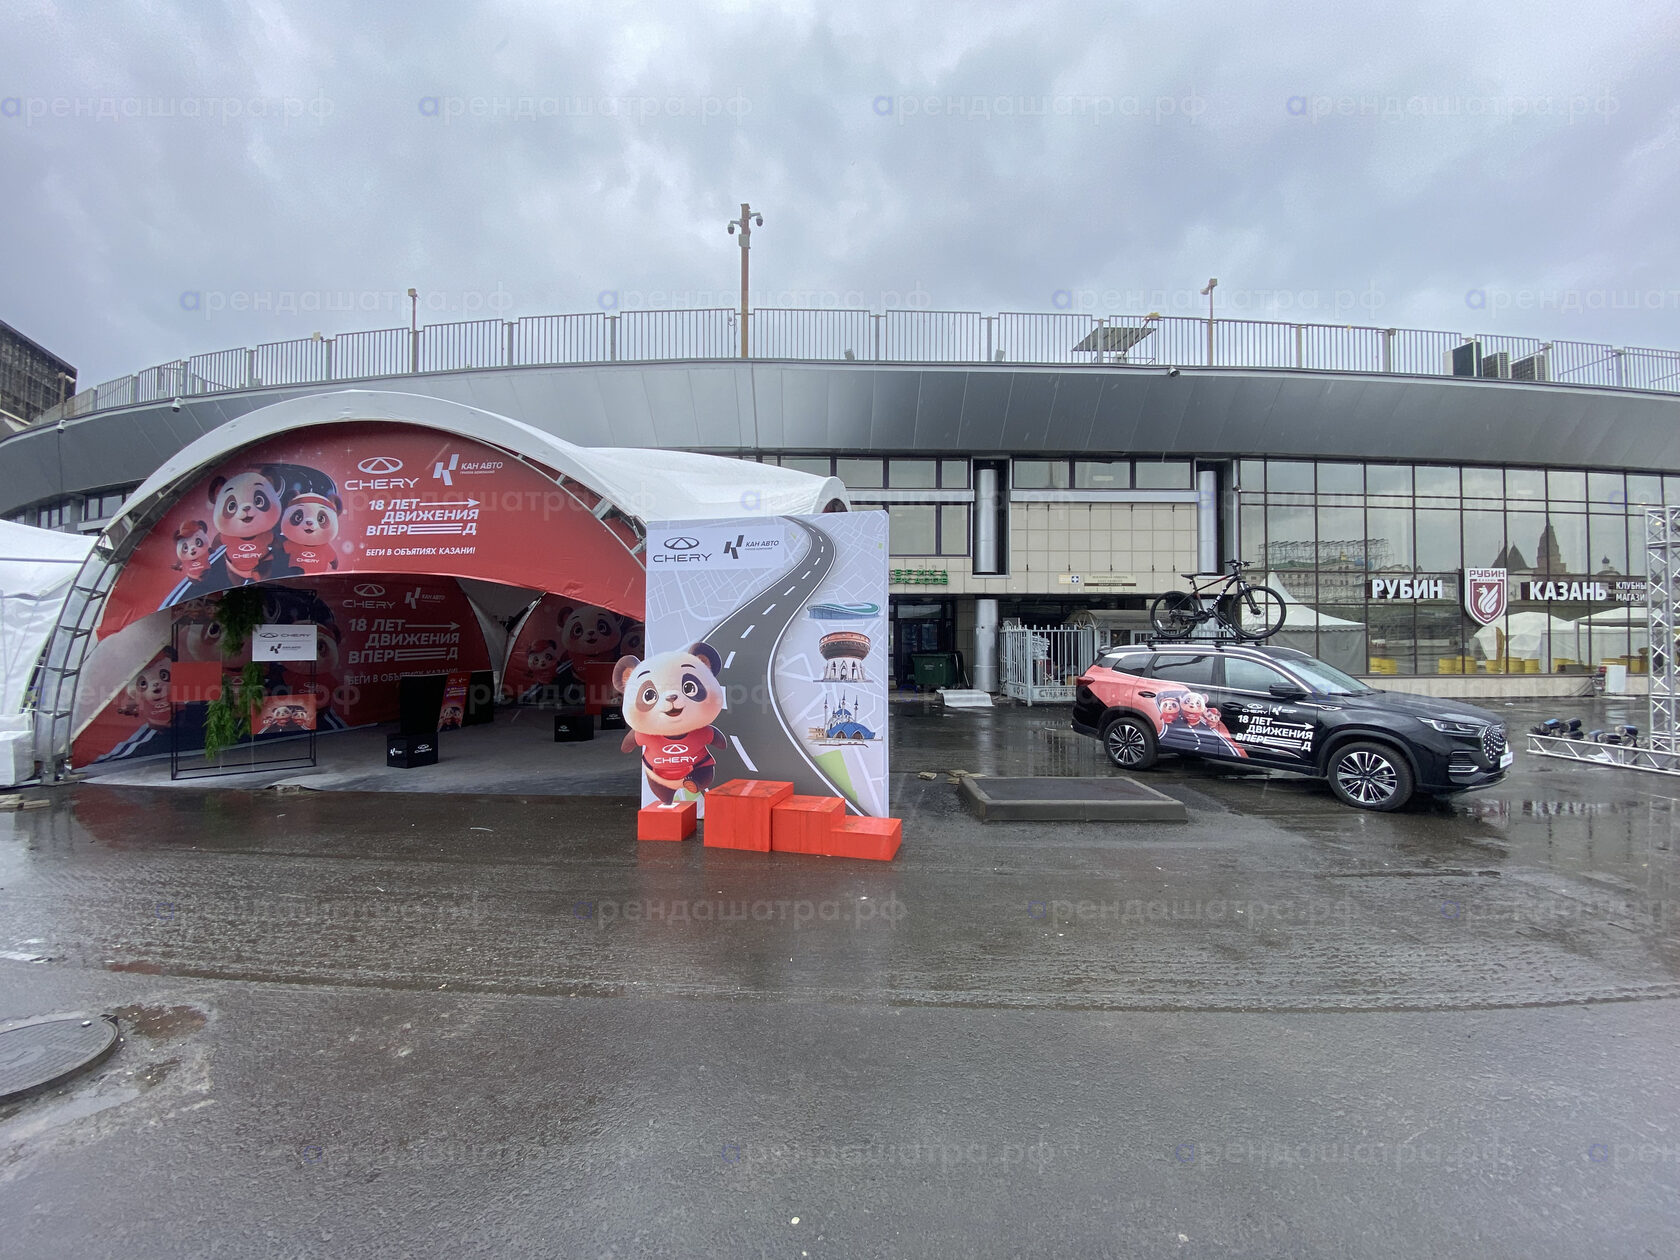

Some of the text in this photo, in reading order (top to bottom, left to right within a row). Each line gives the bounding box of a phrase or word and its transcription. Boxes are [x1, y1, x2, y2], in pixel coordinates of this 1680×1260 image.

[460, 462, 479, 470] КАН
[479, 461, 504, 470] АВТО
[344, 477, 420, 491] CHERY
[368, 498, 421, 510] 18 ЛЕТ
[381, 509, 480, 524] ДВИЖЕНИЯ
[760, 539, 780, 547] АВТО
[366, 546, 476, 557] БЕГИ В ОБЪЯТИЯХ КАЗАНИ!
[652, 553, 712, 563] CHERY
[1469, 569, 1505, 578] РУБИН
[1371, 579, 1607, 601] РУБИН КАЗАНЬ
[1615, 581, 1648, 590] КЛУБНЫ
[1615, 593, 1648, 602] МАГАЗИ
[342, 599, 396, 609] CHERY
[348, 618, 406, 632] 18 ЛЕТ
[365, 632, 460, 649] ДВИЖЕНИЯ
[1237, 714, 1273, 726] 18 ЛЕТ
[1246, 724, 1314, 740] ДВИЖЕНИЯ
[653, 755, 698, 764] CHERY
